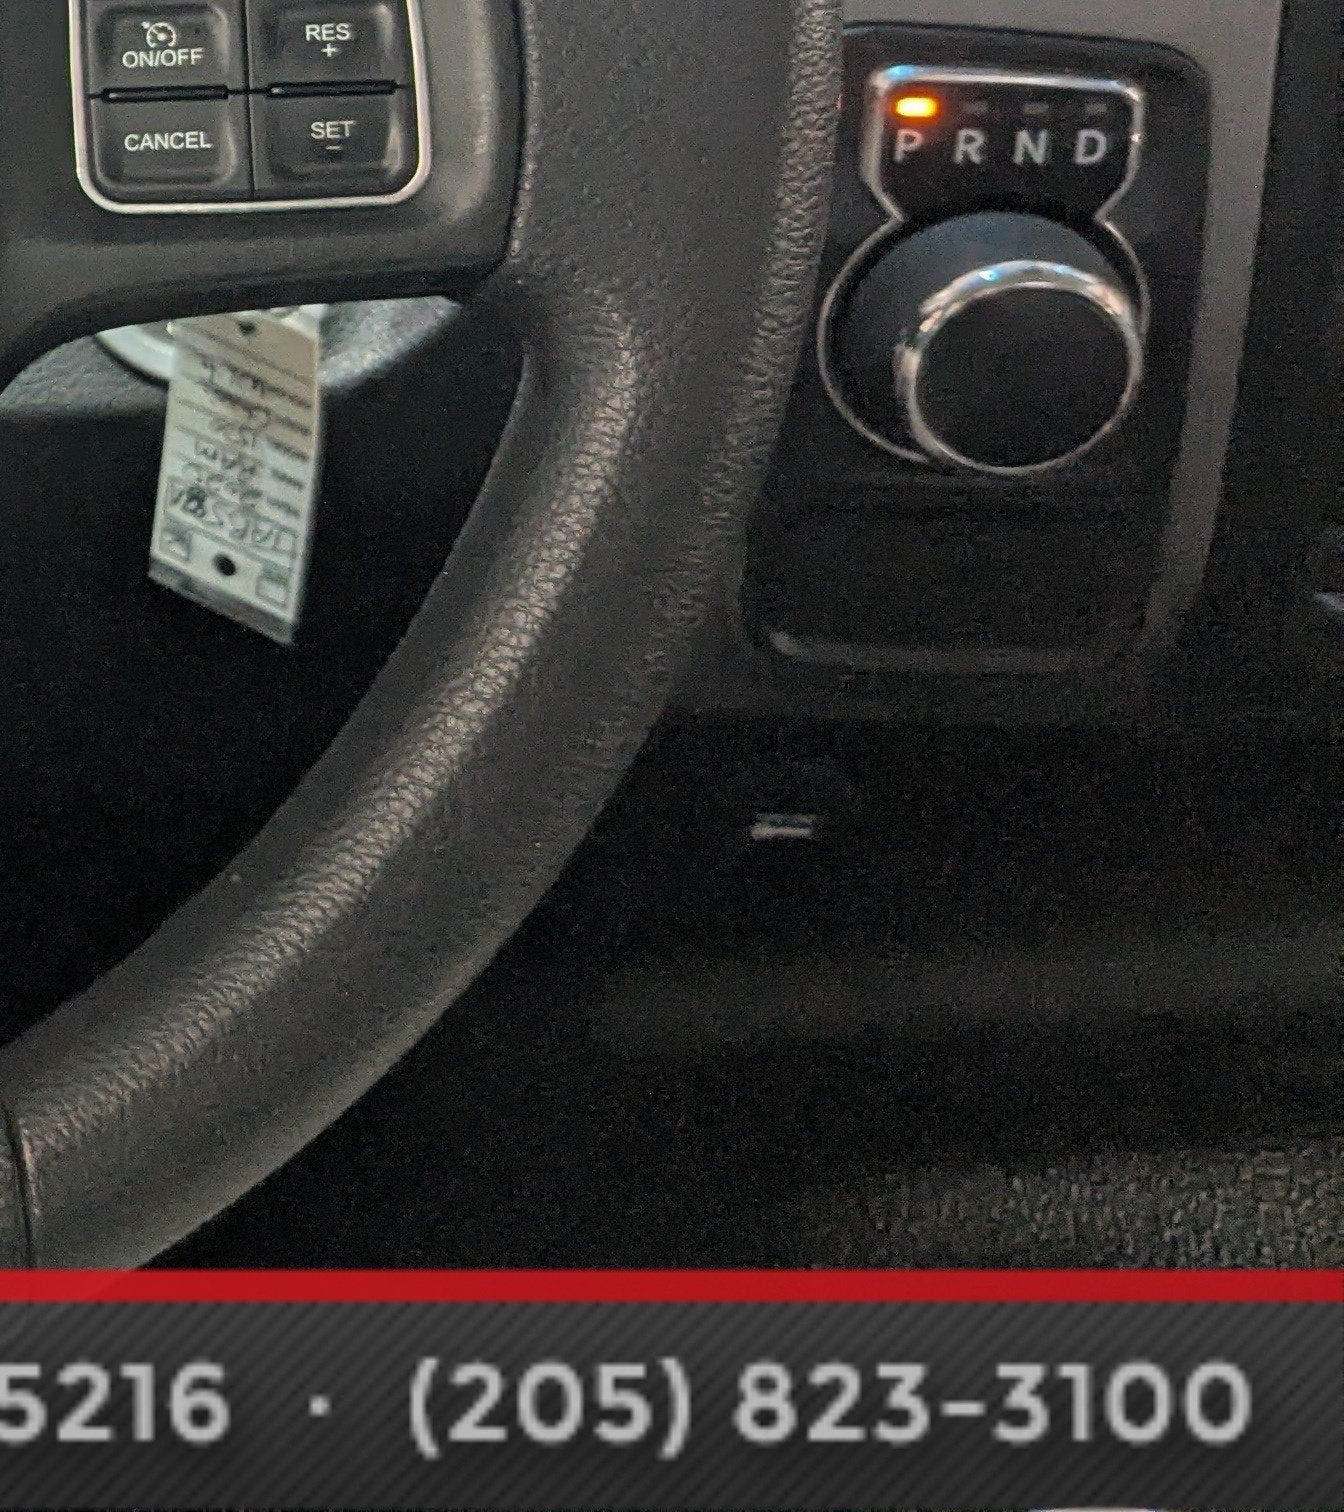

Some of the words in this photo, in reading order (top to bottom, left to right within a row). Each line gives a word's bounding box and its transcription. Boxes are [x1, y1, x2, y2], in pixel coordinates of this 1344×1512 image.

[305, 23, 352, 42] RES
[121, 47, 204, 69] ON/OFF
[310, 120, 356, 140] SET
[123, 131, 213, 152] CANCEL
[894, 128, 923, 164] P
[954, 128, 986, 165] R
[1013, 129, 1050, 165] N
[1074, 128, 1108, 165] D
